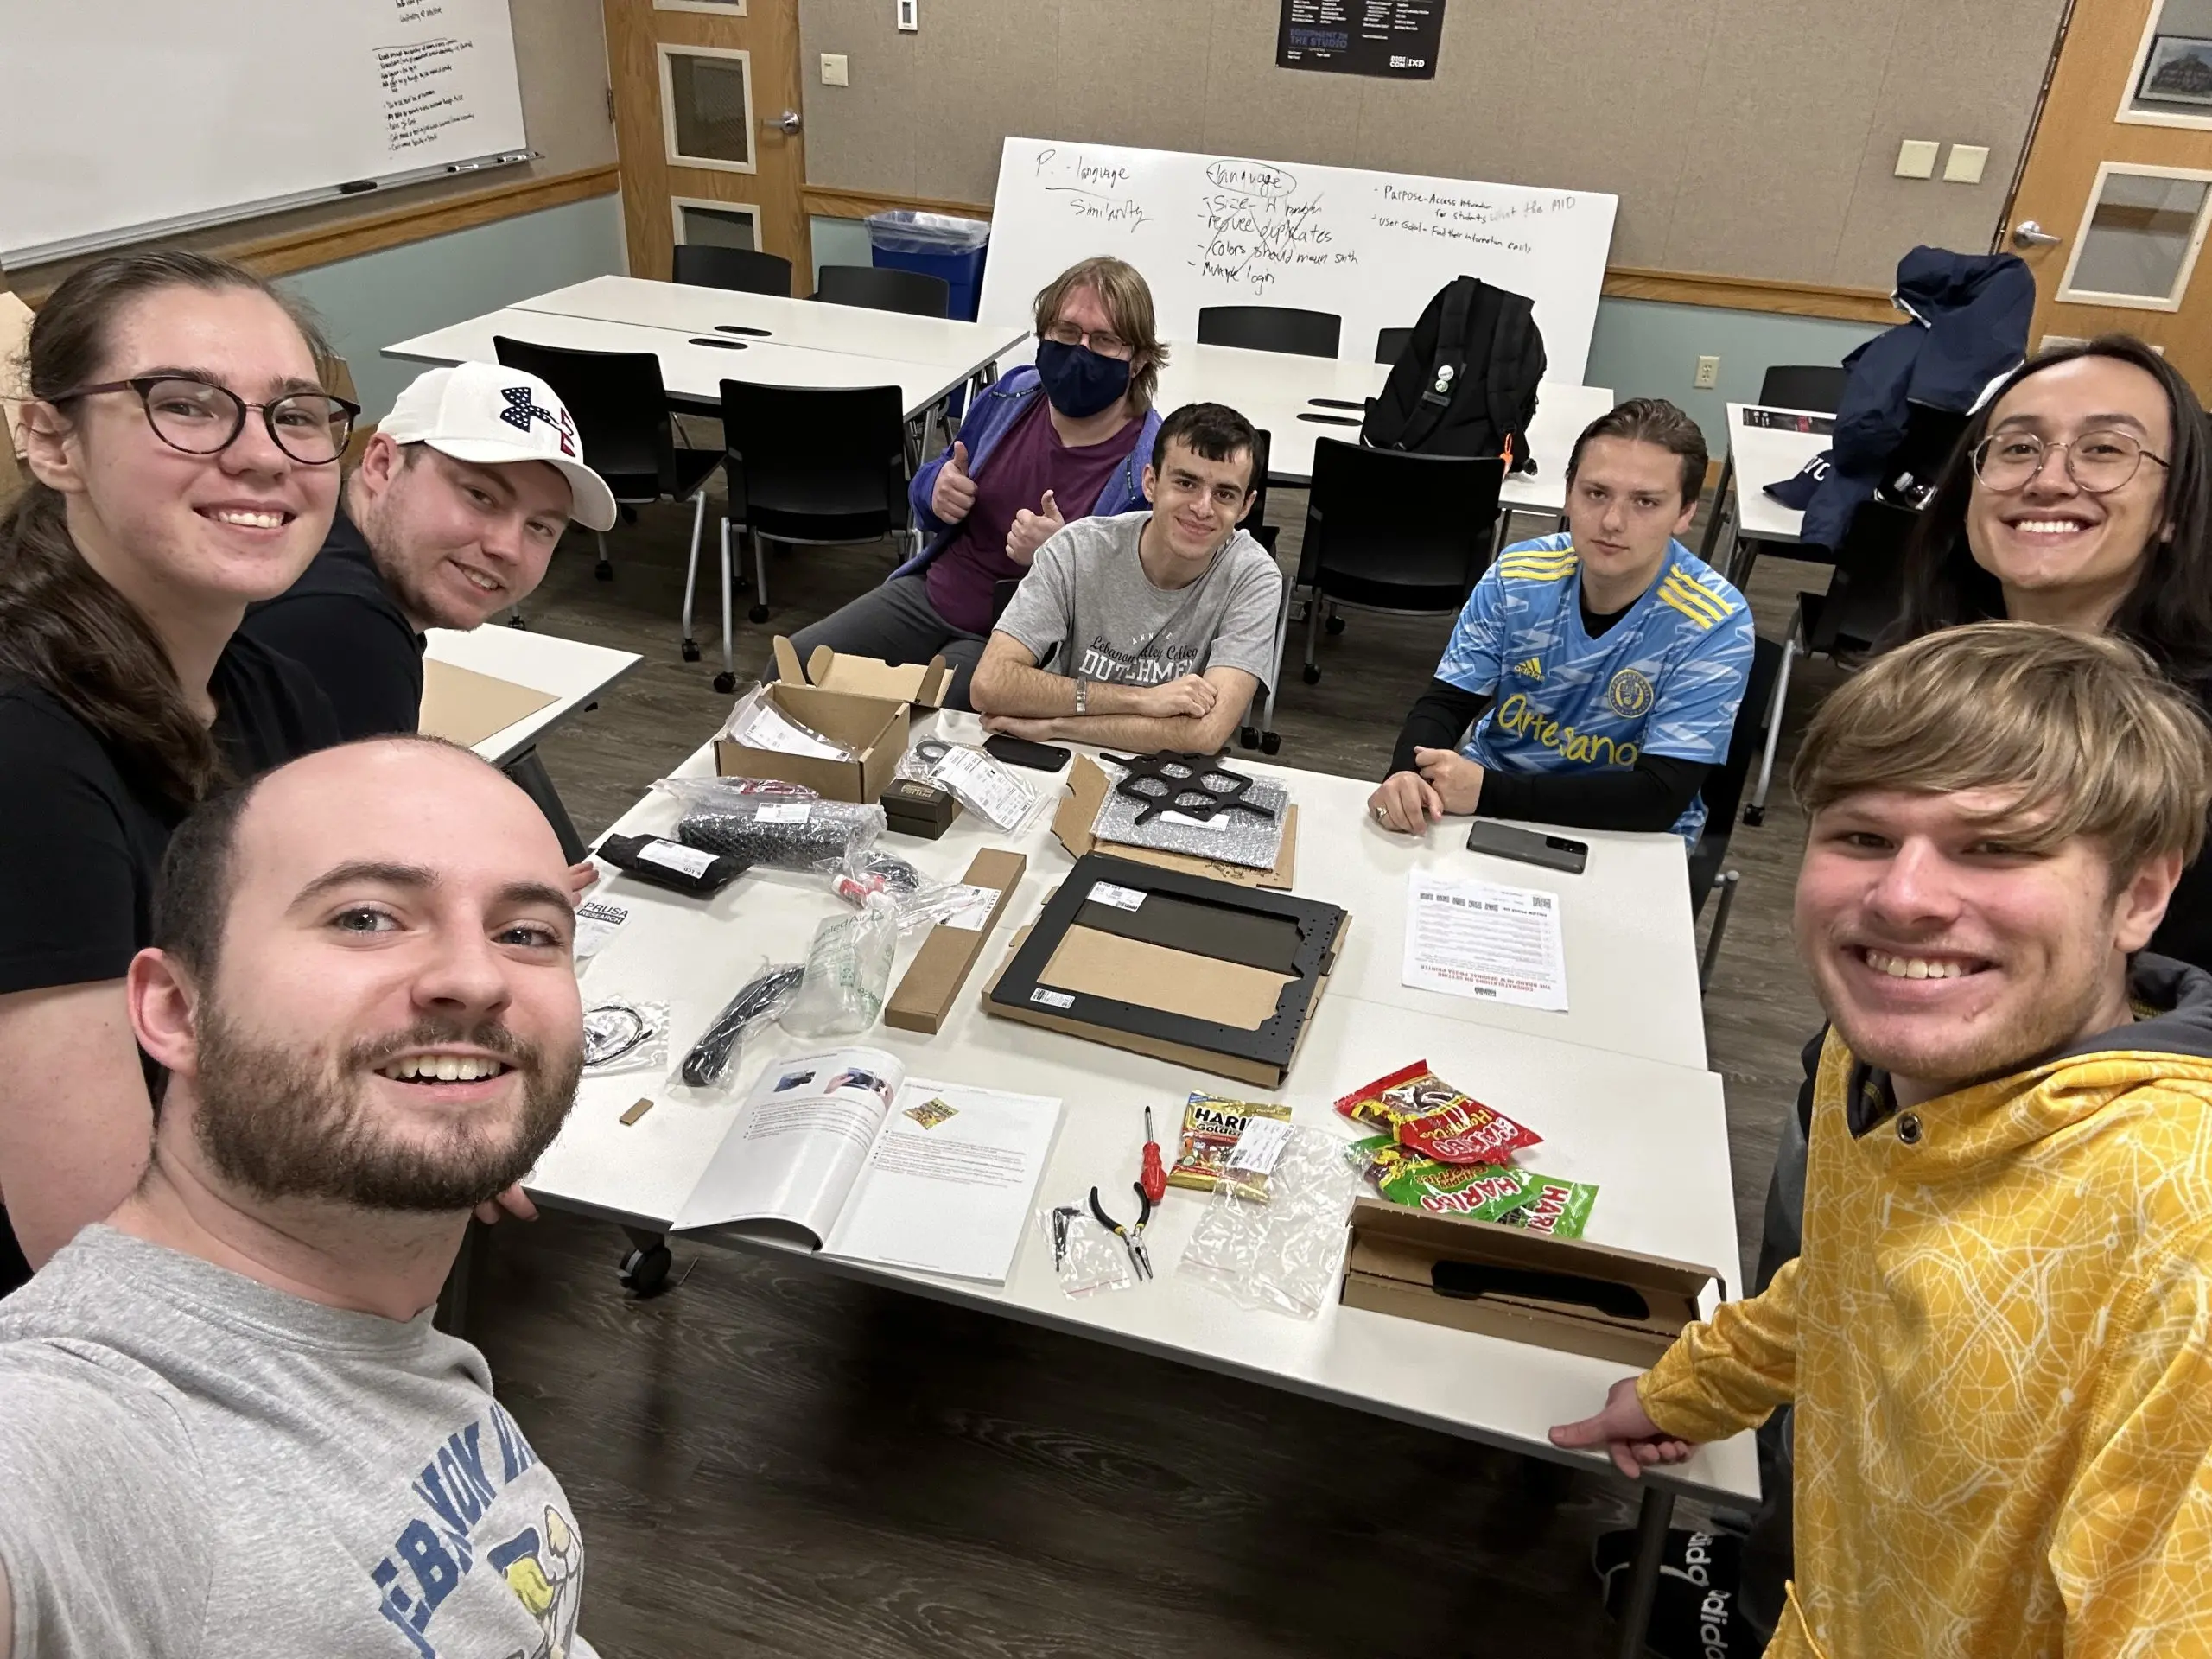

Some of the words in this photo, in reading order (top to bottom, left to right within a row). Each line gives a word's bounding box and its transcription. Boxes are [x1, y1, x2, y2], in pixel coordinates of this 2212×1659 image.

[1290, 36, 1308, 46] THE
[1310, 38, 1348, 48] STUDIO
[1408, 58, 1425, 67] IXD
[1090, 635, 1136, 664] Lebanon
[580, 910, 622, 925] RESEARCH
[583, 902, 629, 918] PRUSA
[1420, 1176, 1522, 1214] HARIBO
